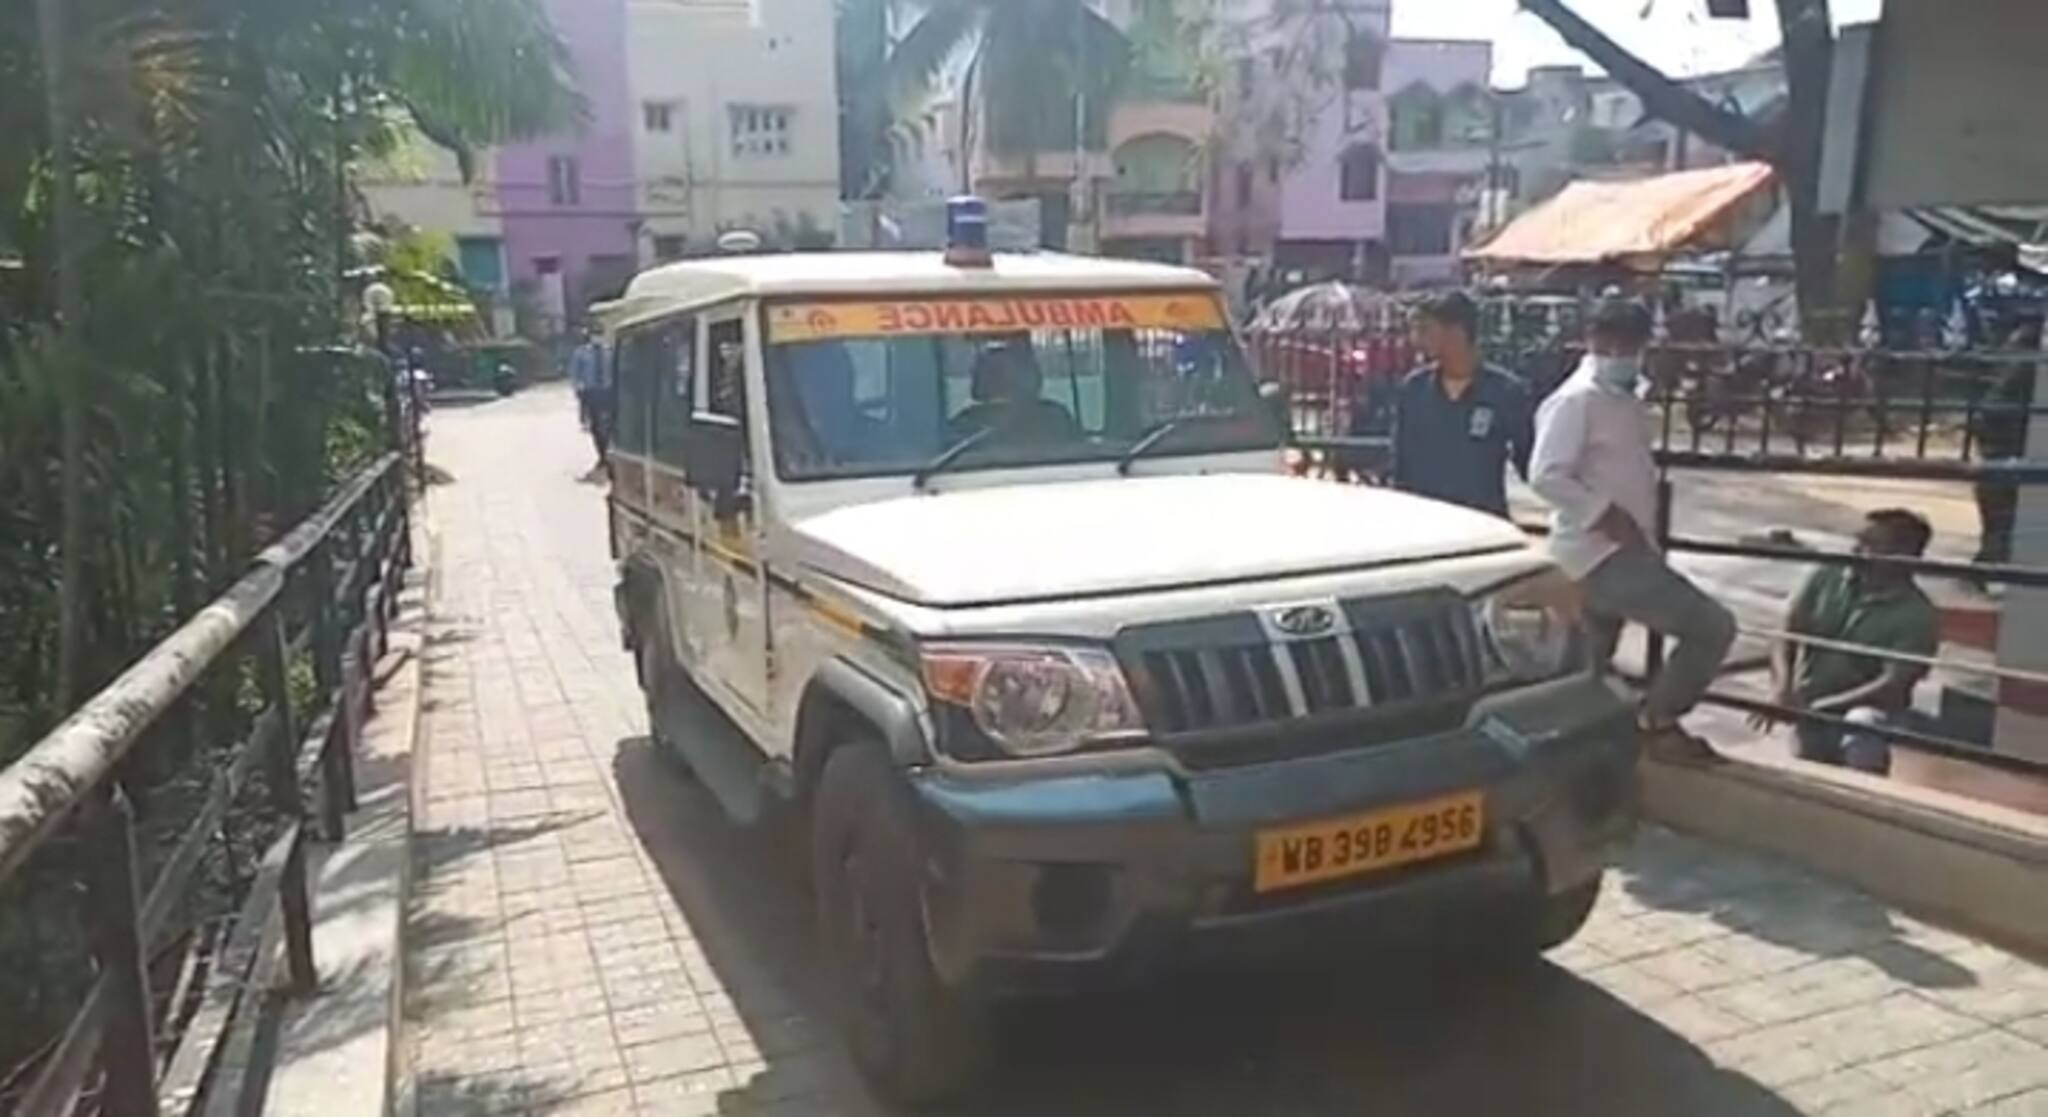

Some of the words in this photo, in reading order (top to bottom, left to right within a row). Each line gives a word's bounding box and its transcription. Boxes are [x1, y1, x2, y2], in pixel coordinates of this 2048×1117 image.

[1283, 836, 1324, 873] WB
[1332, 824, 1392, 867] 39B
[1400, 804, 1476, 850] 4956
